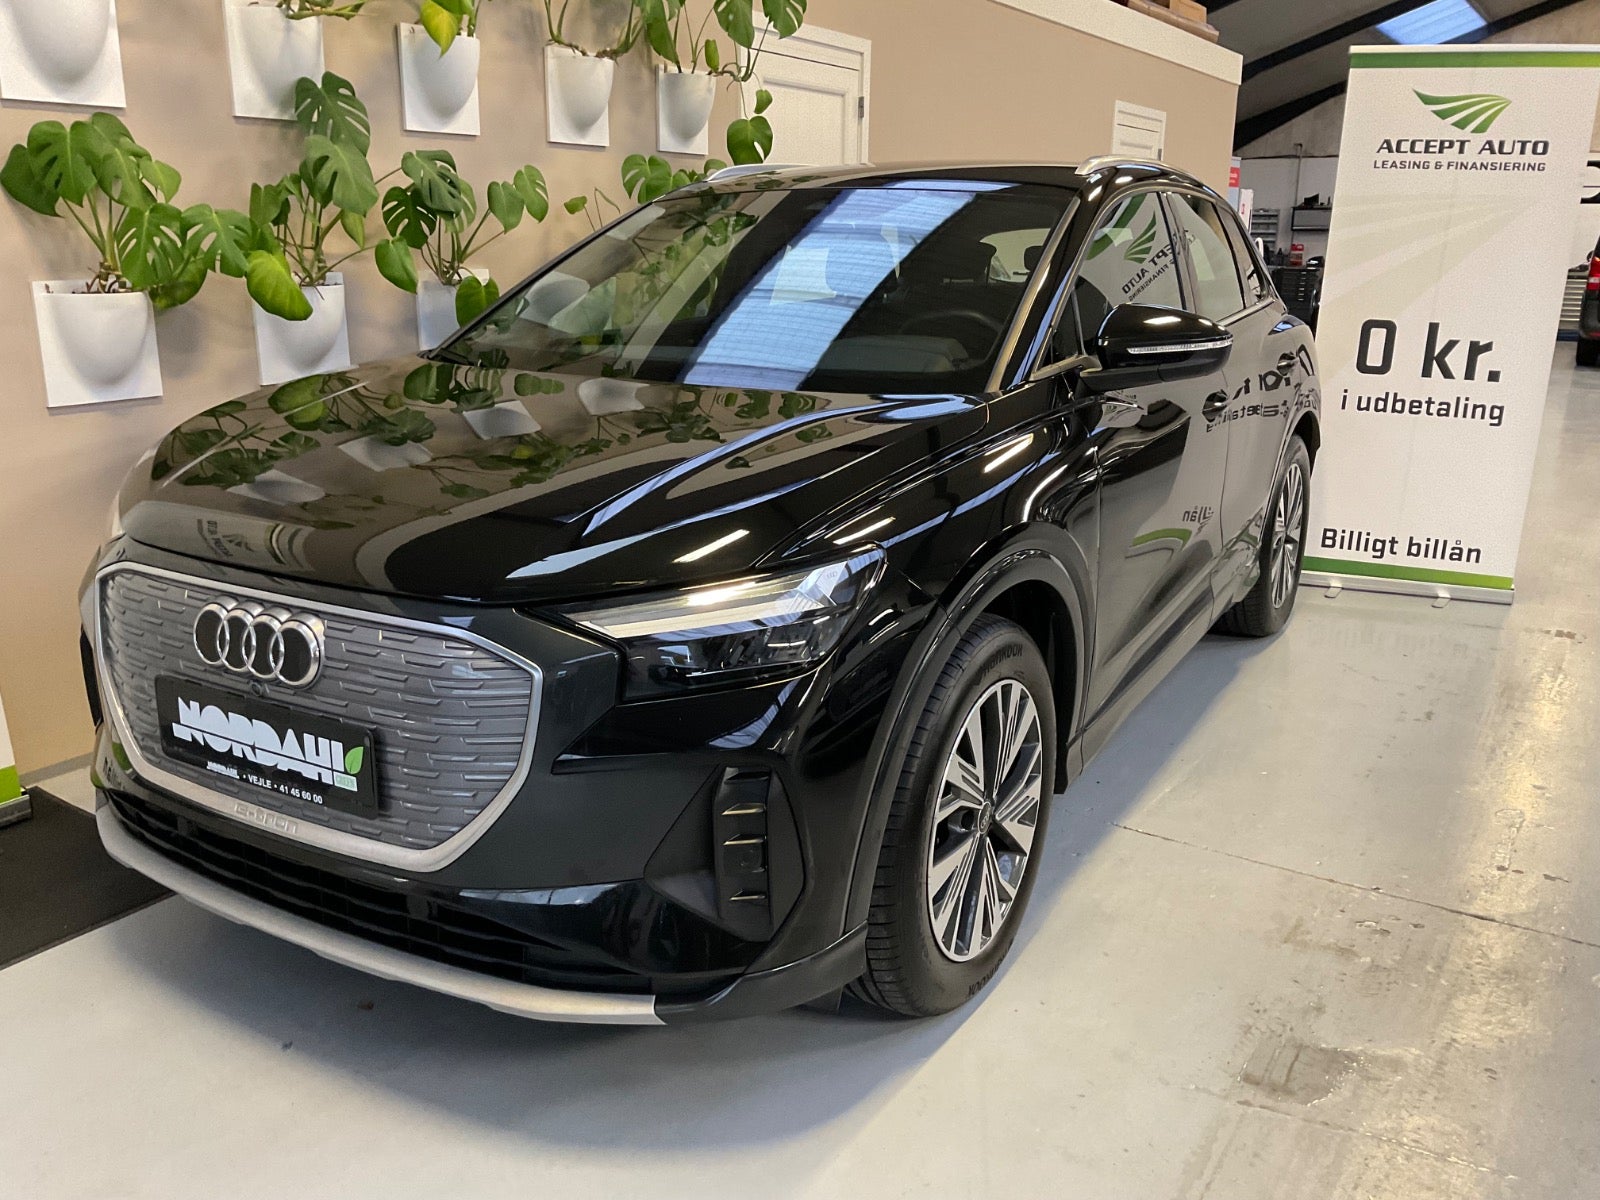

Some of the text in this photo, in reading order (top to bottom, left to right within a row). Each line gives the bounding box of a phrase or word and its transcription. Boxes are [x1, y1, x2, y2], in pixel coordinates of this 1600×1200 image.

[1376, 138, 1549, 155] ACCEPT AUTO
[1373, 159, 1546, 172] LEASING & FINANSIERING
[1355, 319, 1501, 382] 0 kr.
[1341, 389, 1505, 427] i udbetaling
[1320, 528, 1482, 563] Billigt billån
[248, 774, 323, 804] VEJLE 41 45 60 00
